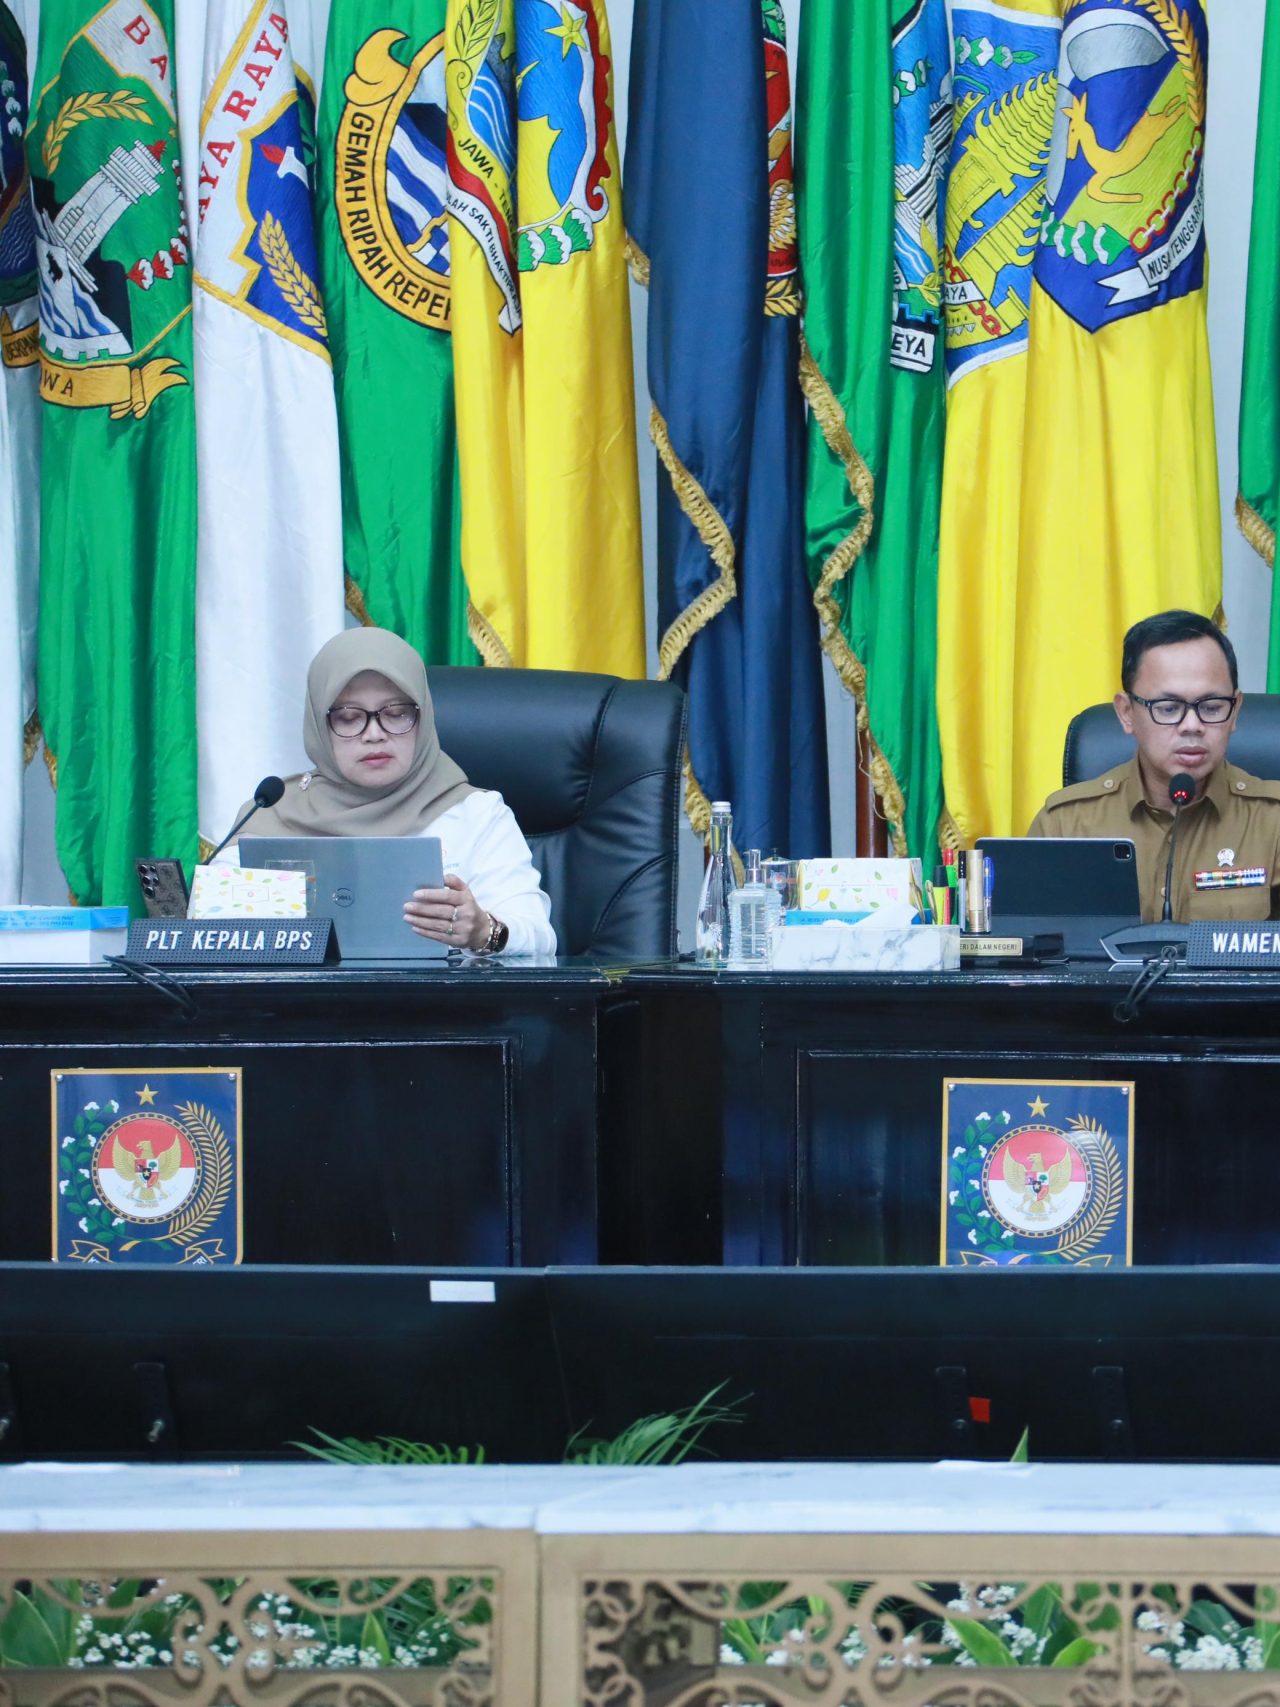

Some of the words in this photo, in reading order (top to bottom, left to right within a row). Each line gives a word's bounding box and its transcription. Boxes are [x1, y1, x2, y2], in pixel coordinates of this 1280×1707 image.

[122, 14, 173, 98] BA
[221, 12, 289, 123] RAYA
[343, 111, 375, 204] GEMAH
[457, 137, 495, 180] JAWA
[346, 207, 394, 280] RIPAH
[468, 206, 495, 246] SAKTI
[145, 930, 183, 950] PLT
[191, 930, 265, 951] KEPALA
[274, 931, 313, 951] BPS
[970, 943, 992, 951] DALAM
[993, 943, 1018, 951] NEGERI
